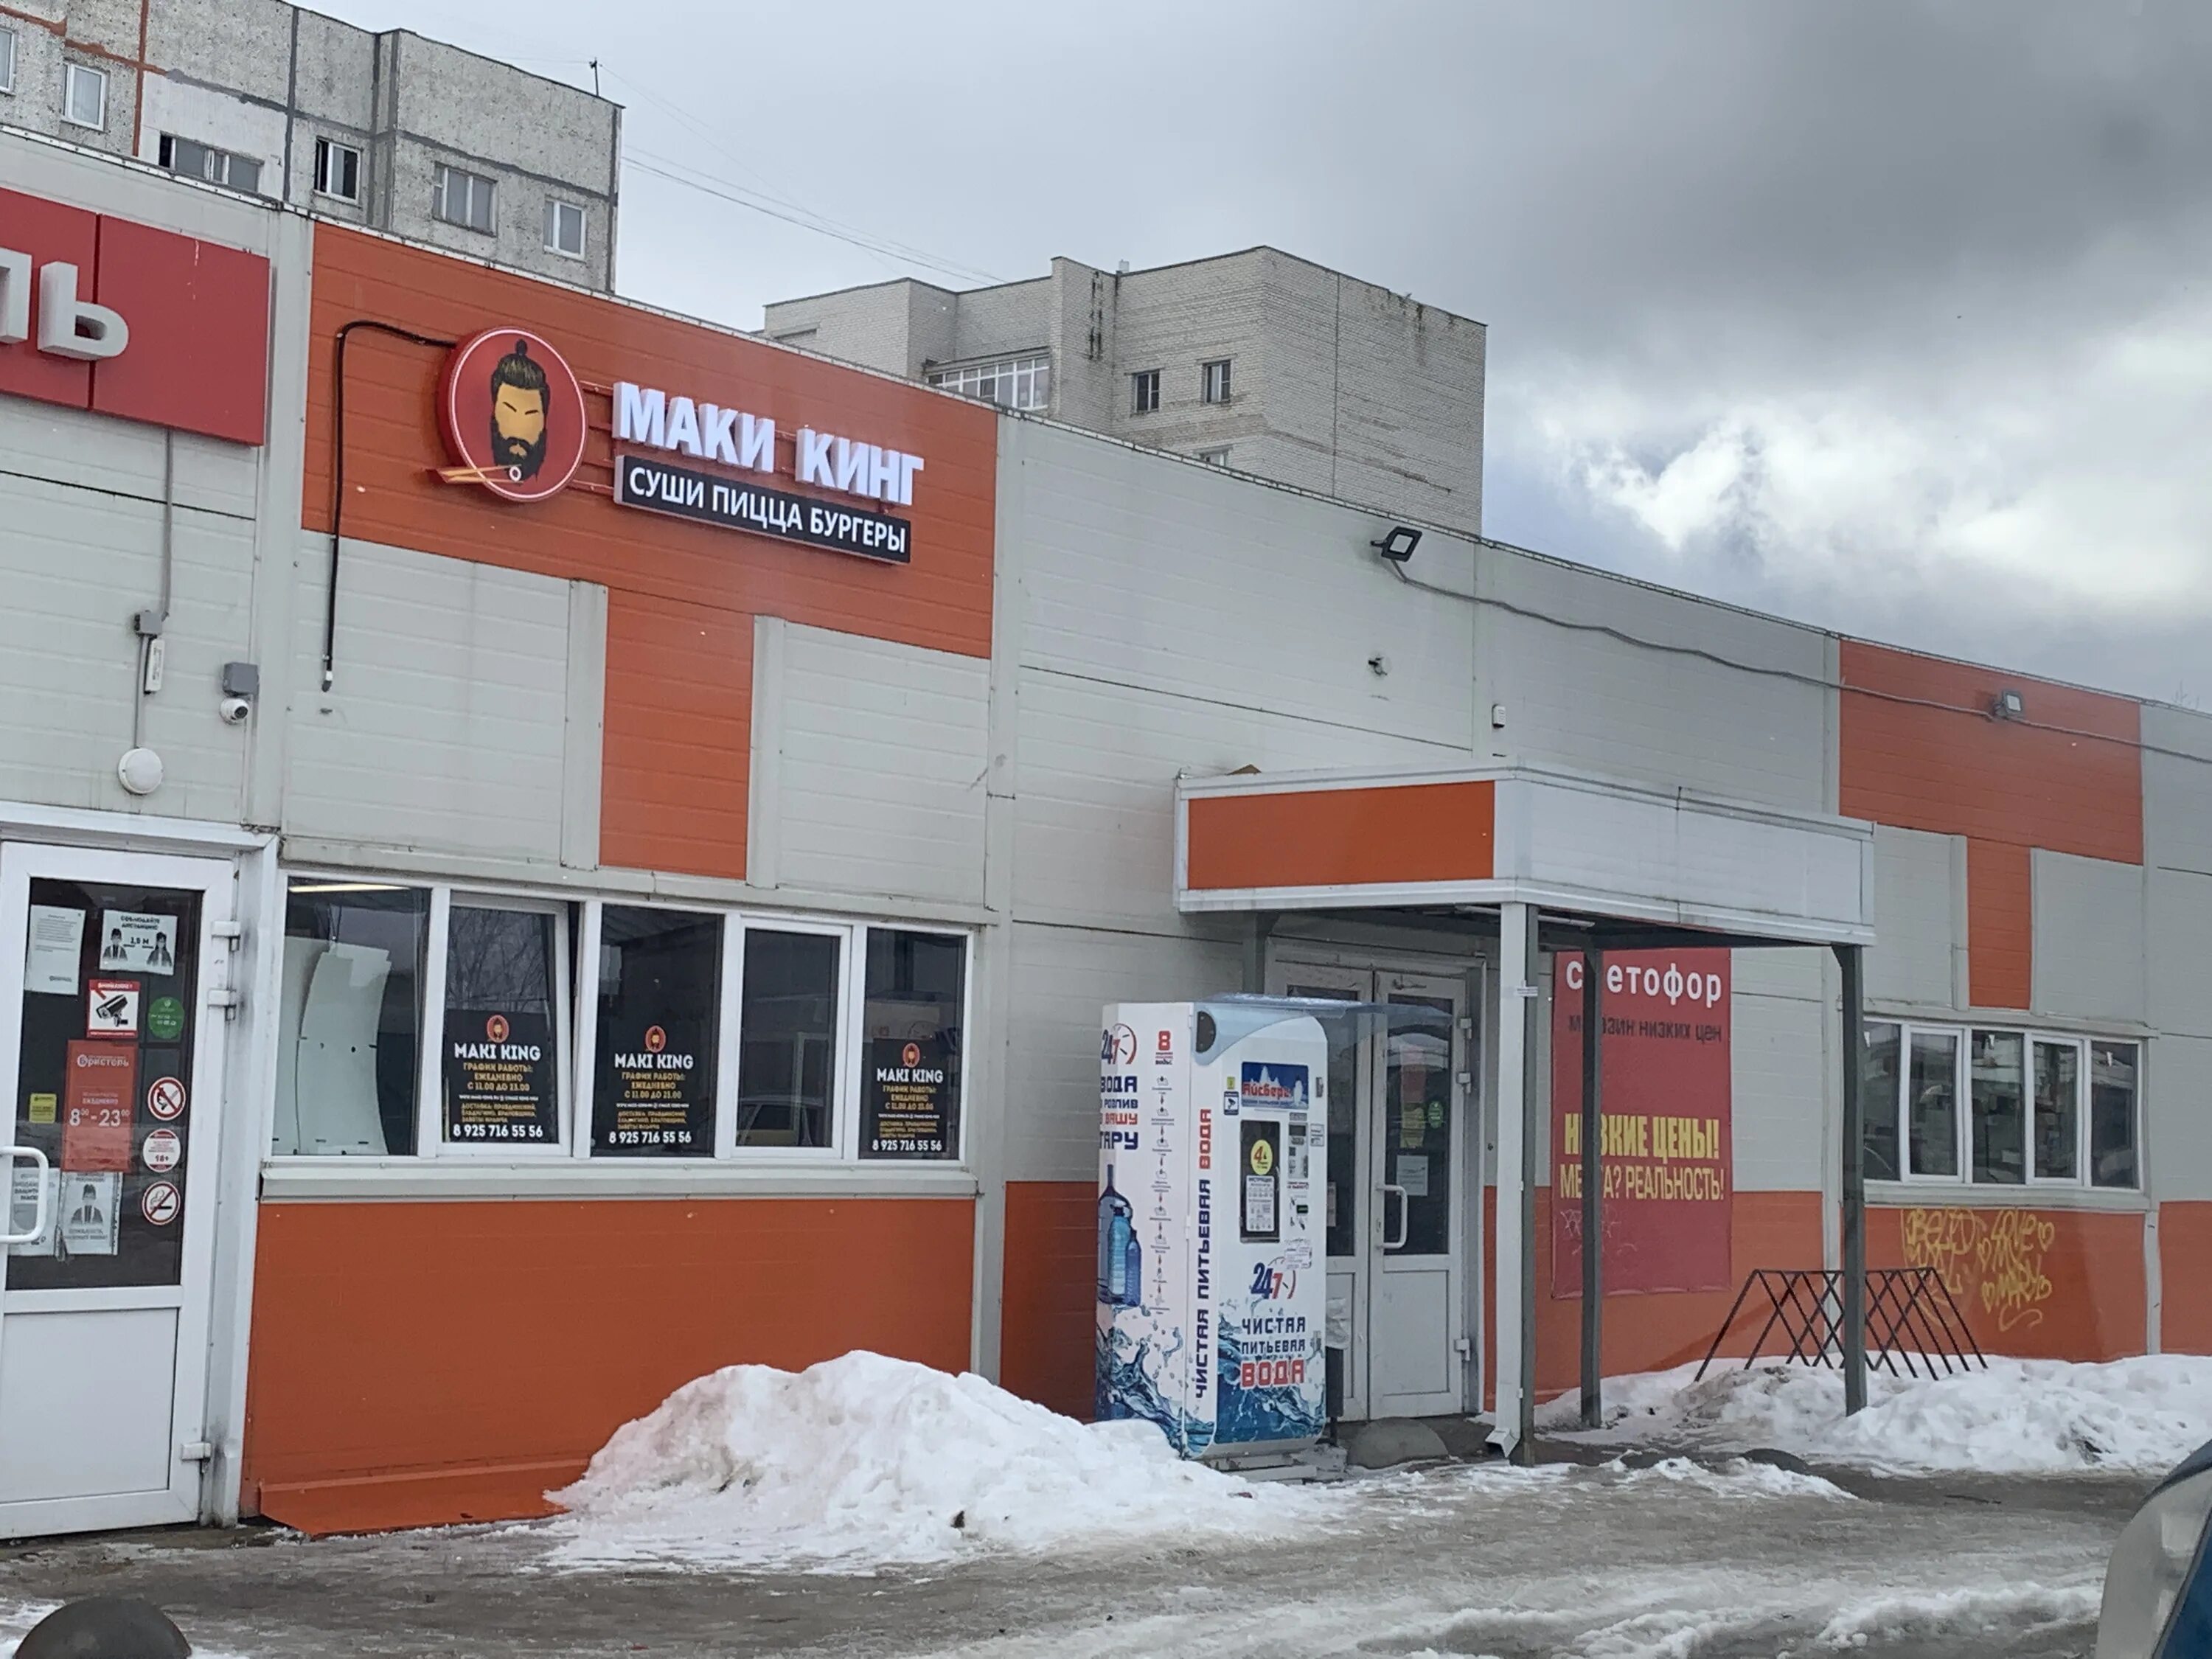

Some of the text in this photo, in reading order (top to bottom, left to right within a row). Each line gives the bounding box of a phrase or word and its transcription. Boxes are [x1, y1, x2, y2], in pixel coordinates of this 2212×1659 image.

[611, 381, 925, 507] МАКИ КИНГ
[629, 467, 905, 554] СУШИ ПИЦЦА БУРГЕРЫ
[1566, 960, 1722, 1008] сетофор
[1696, 1024, 1721, 1045] цен
[454, 1043, 541, 1061] MAKI KING
[614, 1053, 694, 1069] MAKI KING
[876, 1068, 944, 1083] MAKI KING
[453, 1124, 543, 1138] 8 925 716 55 56
[608, 1131, 692, 1144] 8 925 716 55 56
[1652, 1116, 1719, 1164] ЦЕНЫ!
[872, 1139, 942, 1151] 8 925 716 55 56
[1560, 1164, 1724, 1201] МЕА? РЕАЛЬНОСТЬ!
[1196, 1109, 1212, 1398] ЧИСТАЯ ПИТЬЕВАЯ ВОДА
[1242, 1317, 1305, 1335] ЧИСТАЯ
[1242, 1339, 1305, 1354] ПИТЬЕВАЯ
[1242, 1359, 1304, 1388] ВОДА
